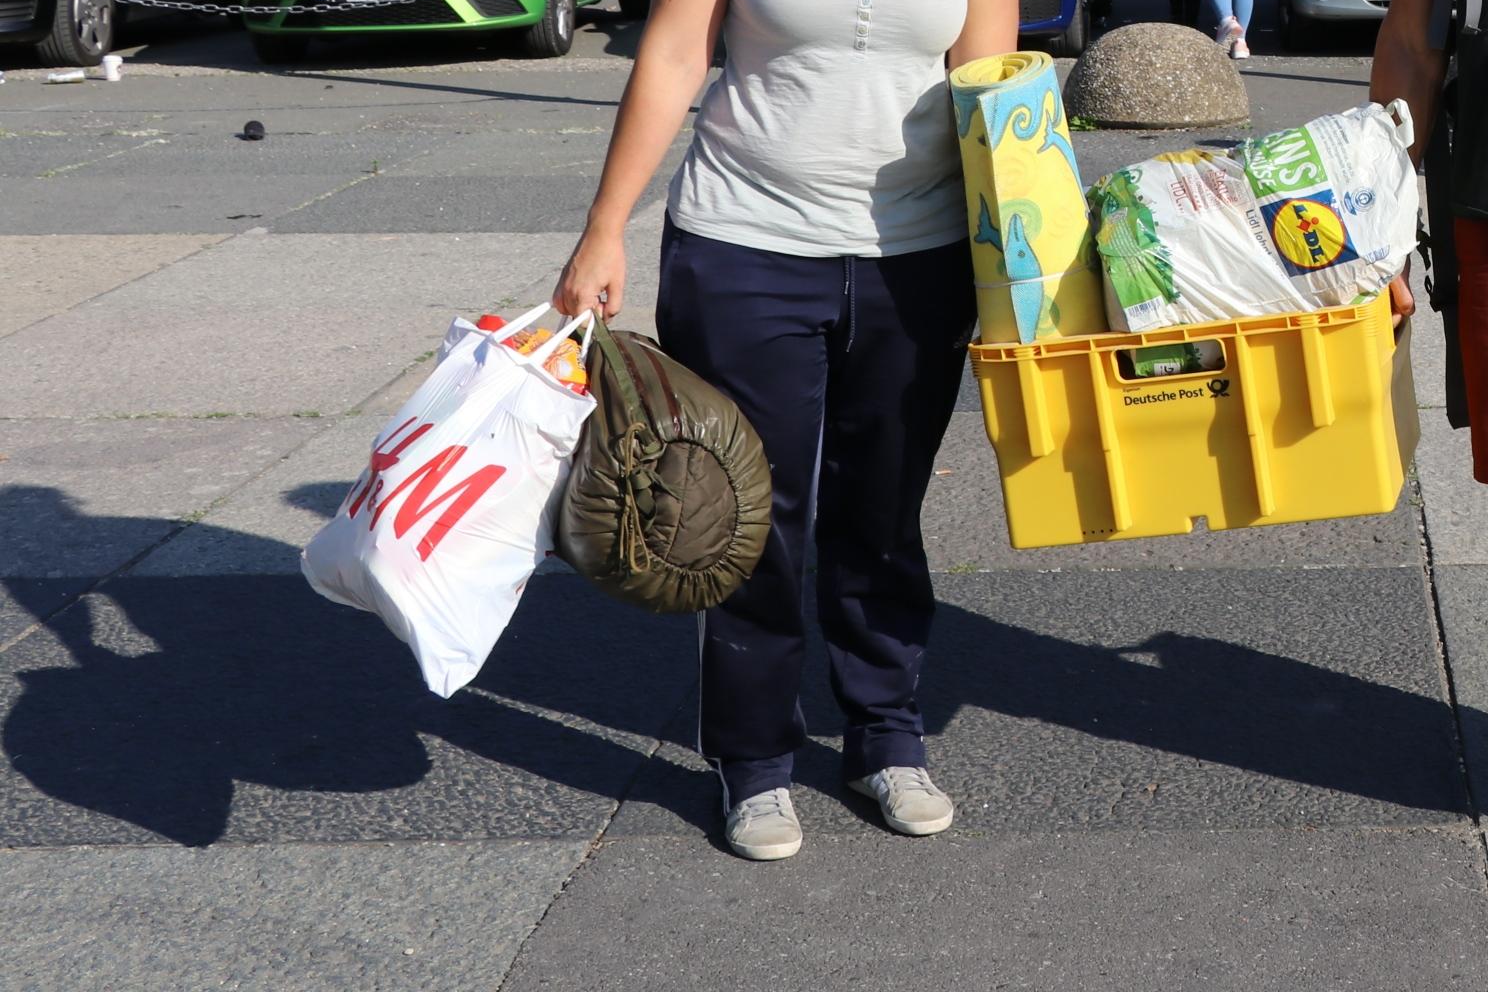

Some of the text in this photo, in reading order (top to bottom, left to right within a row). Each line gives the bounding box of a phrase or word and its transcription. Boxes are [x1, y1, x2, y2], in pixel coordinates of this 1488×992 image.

[1263, 127, 1318, 186] INS
[1245, 209, 1260, 229] Lidl
[1124, 388, 1204, 406] Deutsche Post
